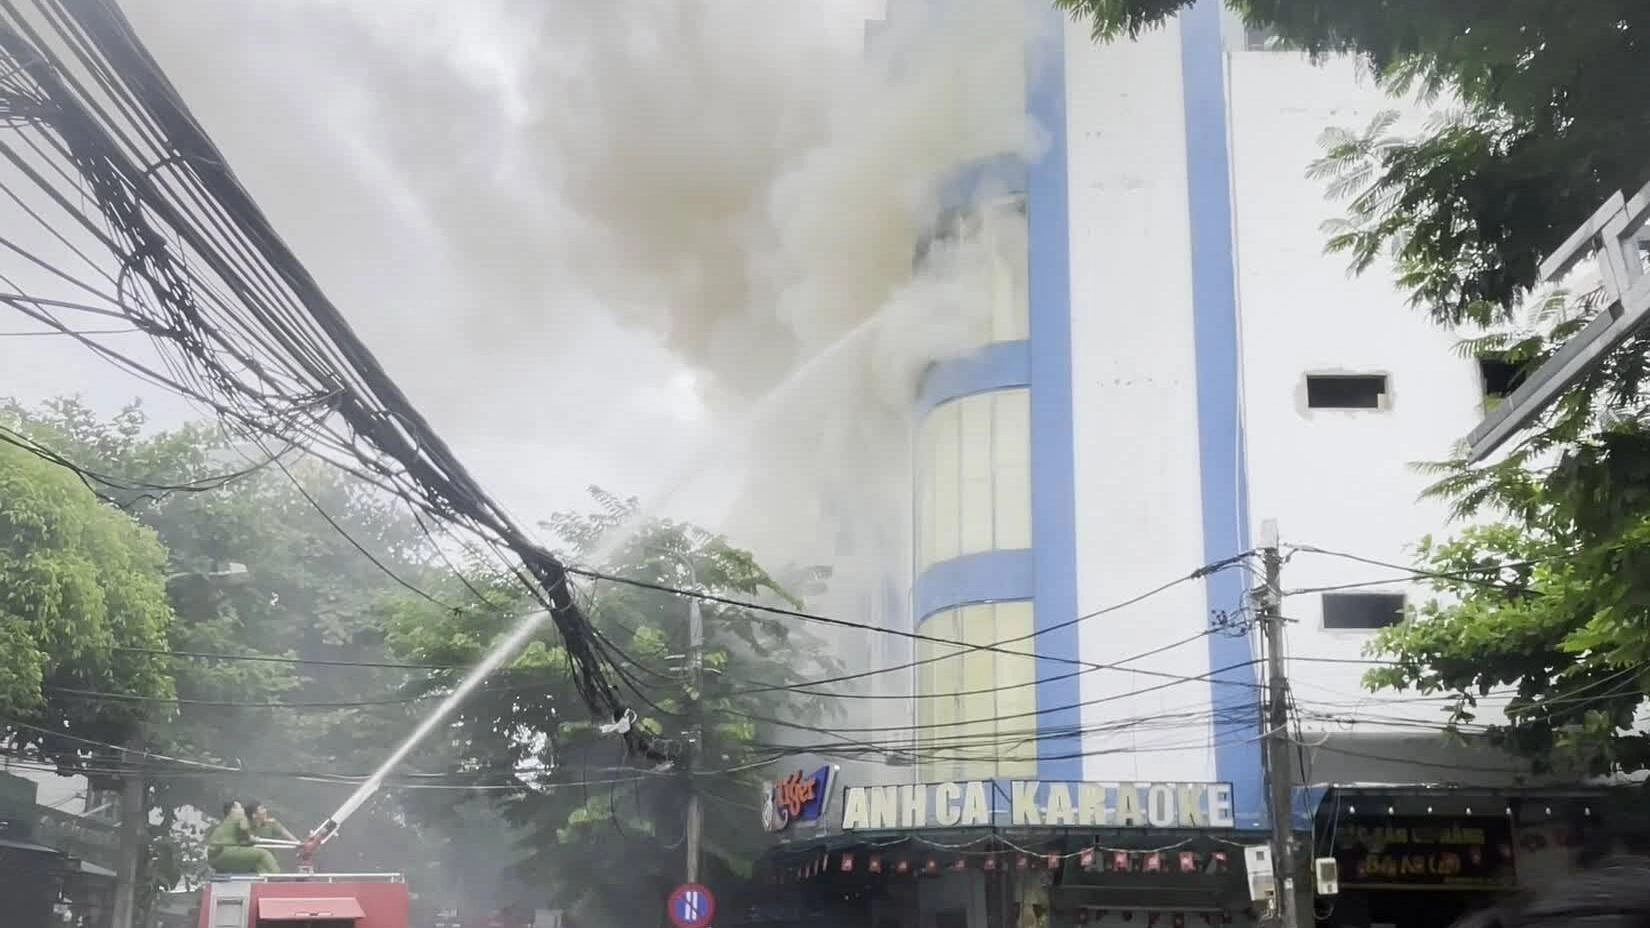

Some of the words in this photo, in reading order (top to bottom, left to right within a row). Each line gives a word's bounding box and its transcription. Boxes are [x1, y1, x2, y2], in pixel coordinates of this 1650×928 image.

[842, 783, 927, 829] ANH
[935, 781, 989, 826] CA
[1011, 781, 1234, 828] KARAOKE
